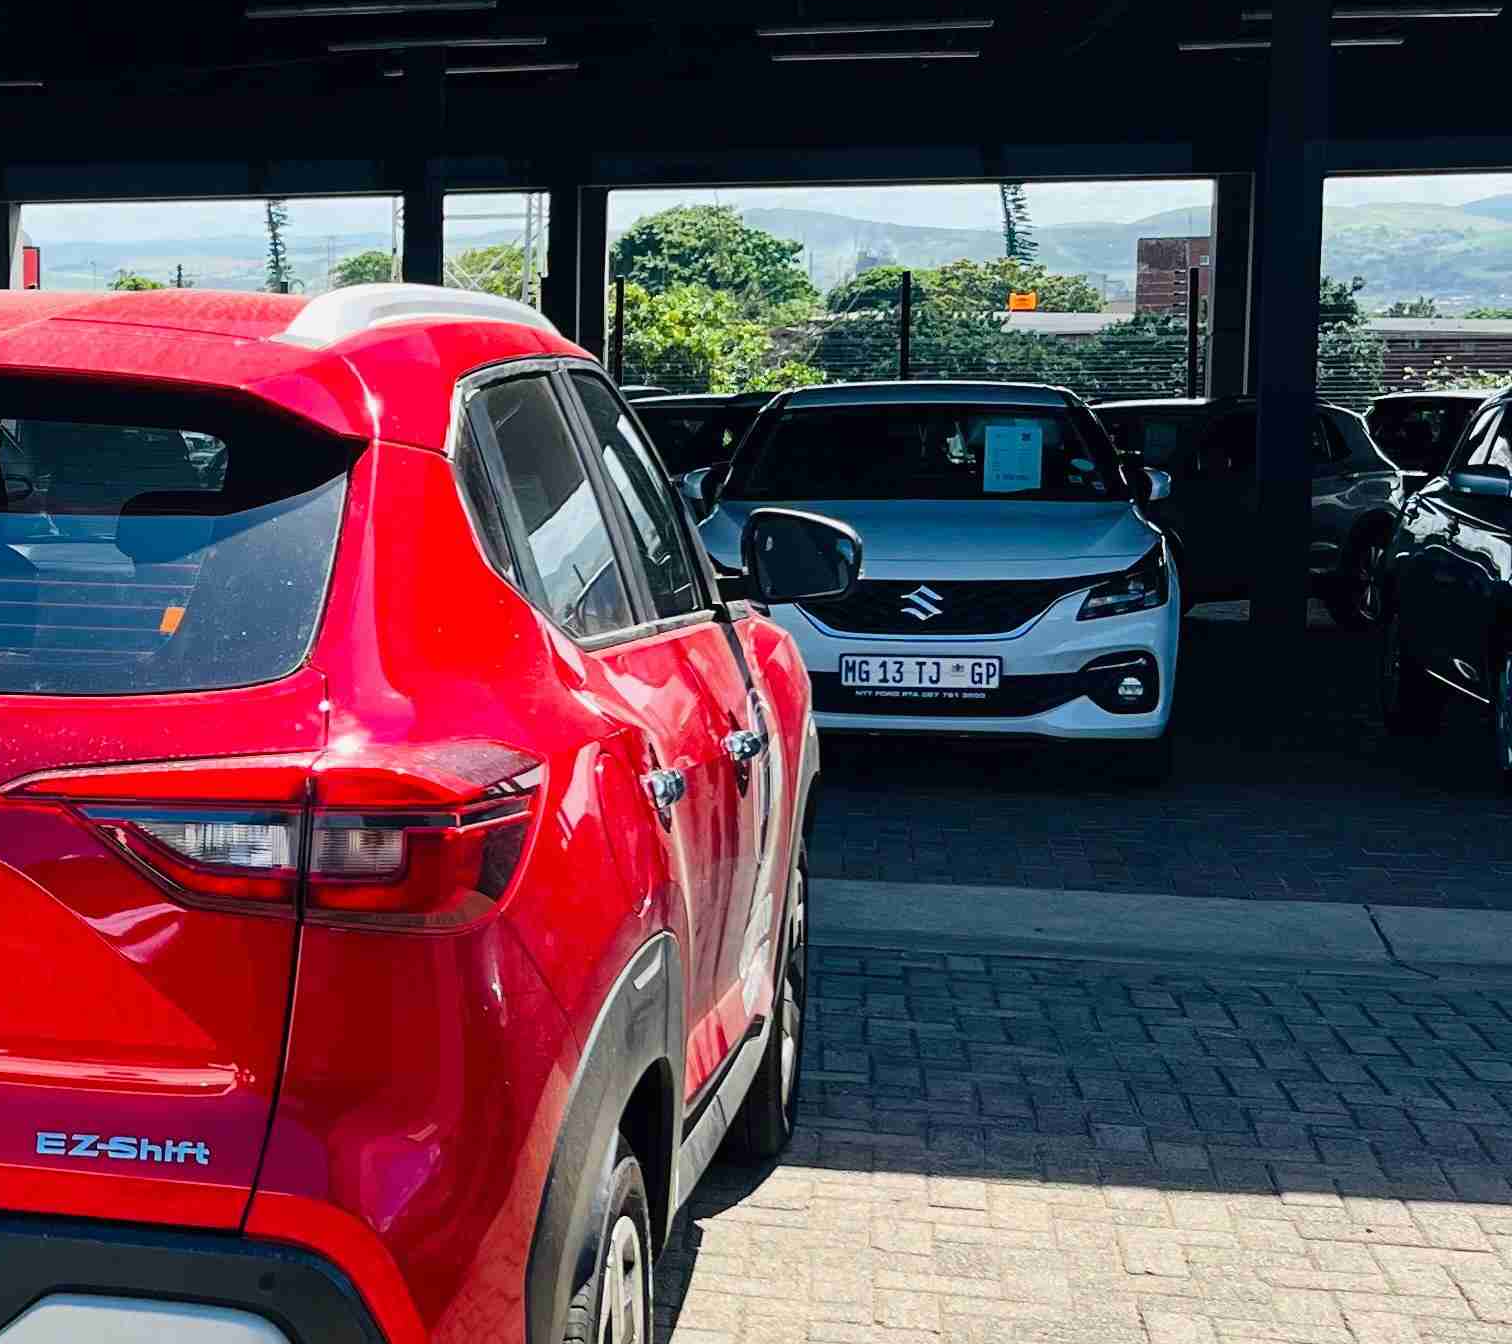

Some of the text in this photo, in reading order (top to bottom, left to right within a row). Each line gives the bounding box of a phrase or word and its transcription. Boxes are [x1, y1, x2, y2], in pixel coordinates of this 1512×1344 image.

[844, 659, 997, 685] MG 13 TJ GP
[36, 1131, 210, 1165] EZ-Shift
